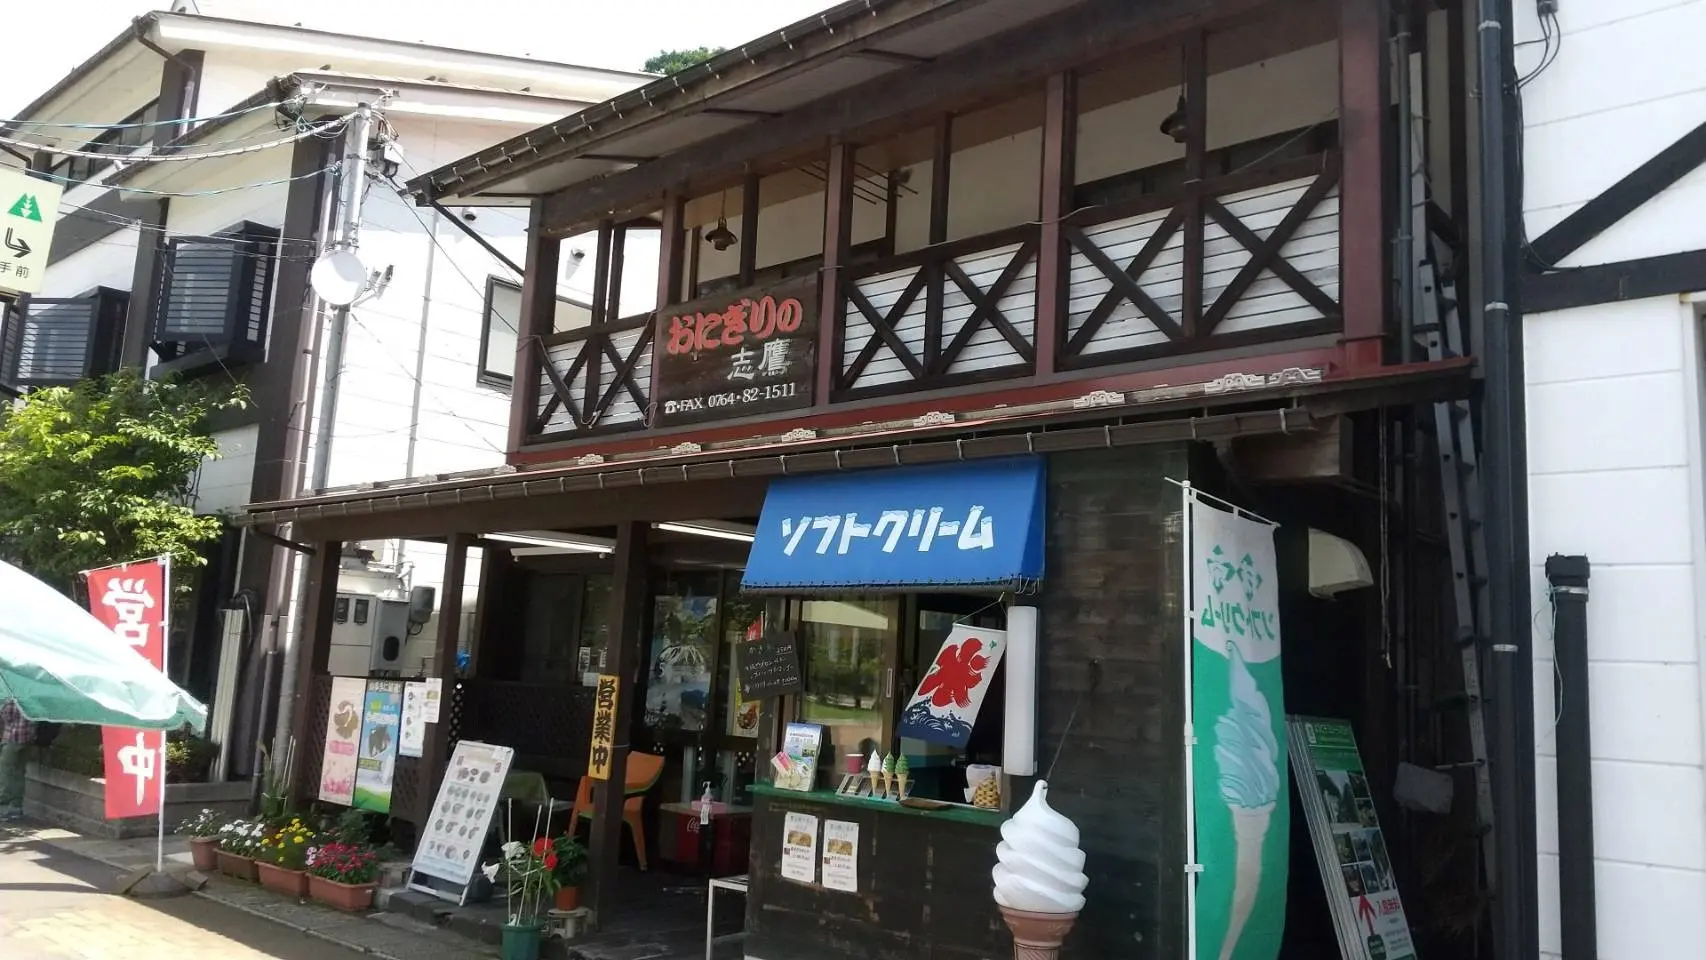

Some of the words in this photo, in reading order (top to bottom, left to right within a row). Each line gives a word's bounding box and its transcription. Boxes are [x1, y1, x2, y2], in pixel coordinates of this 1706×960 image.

[667, 295, 803, 354] おにぎりの
[727, 338, 793, 380] 志鷹
[782, 505, 995, 557] ソフトクリーム
[594, 678, 616, 774] 営業中
